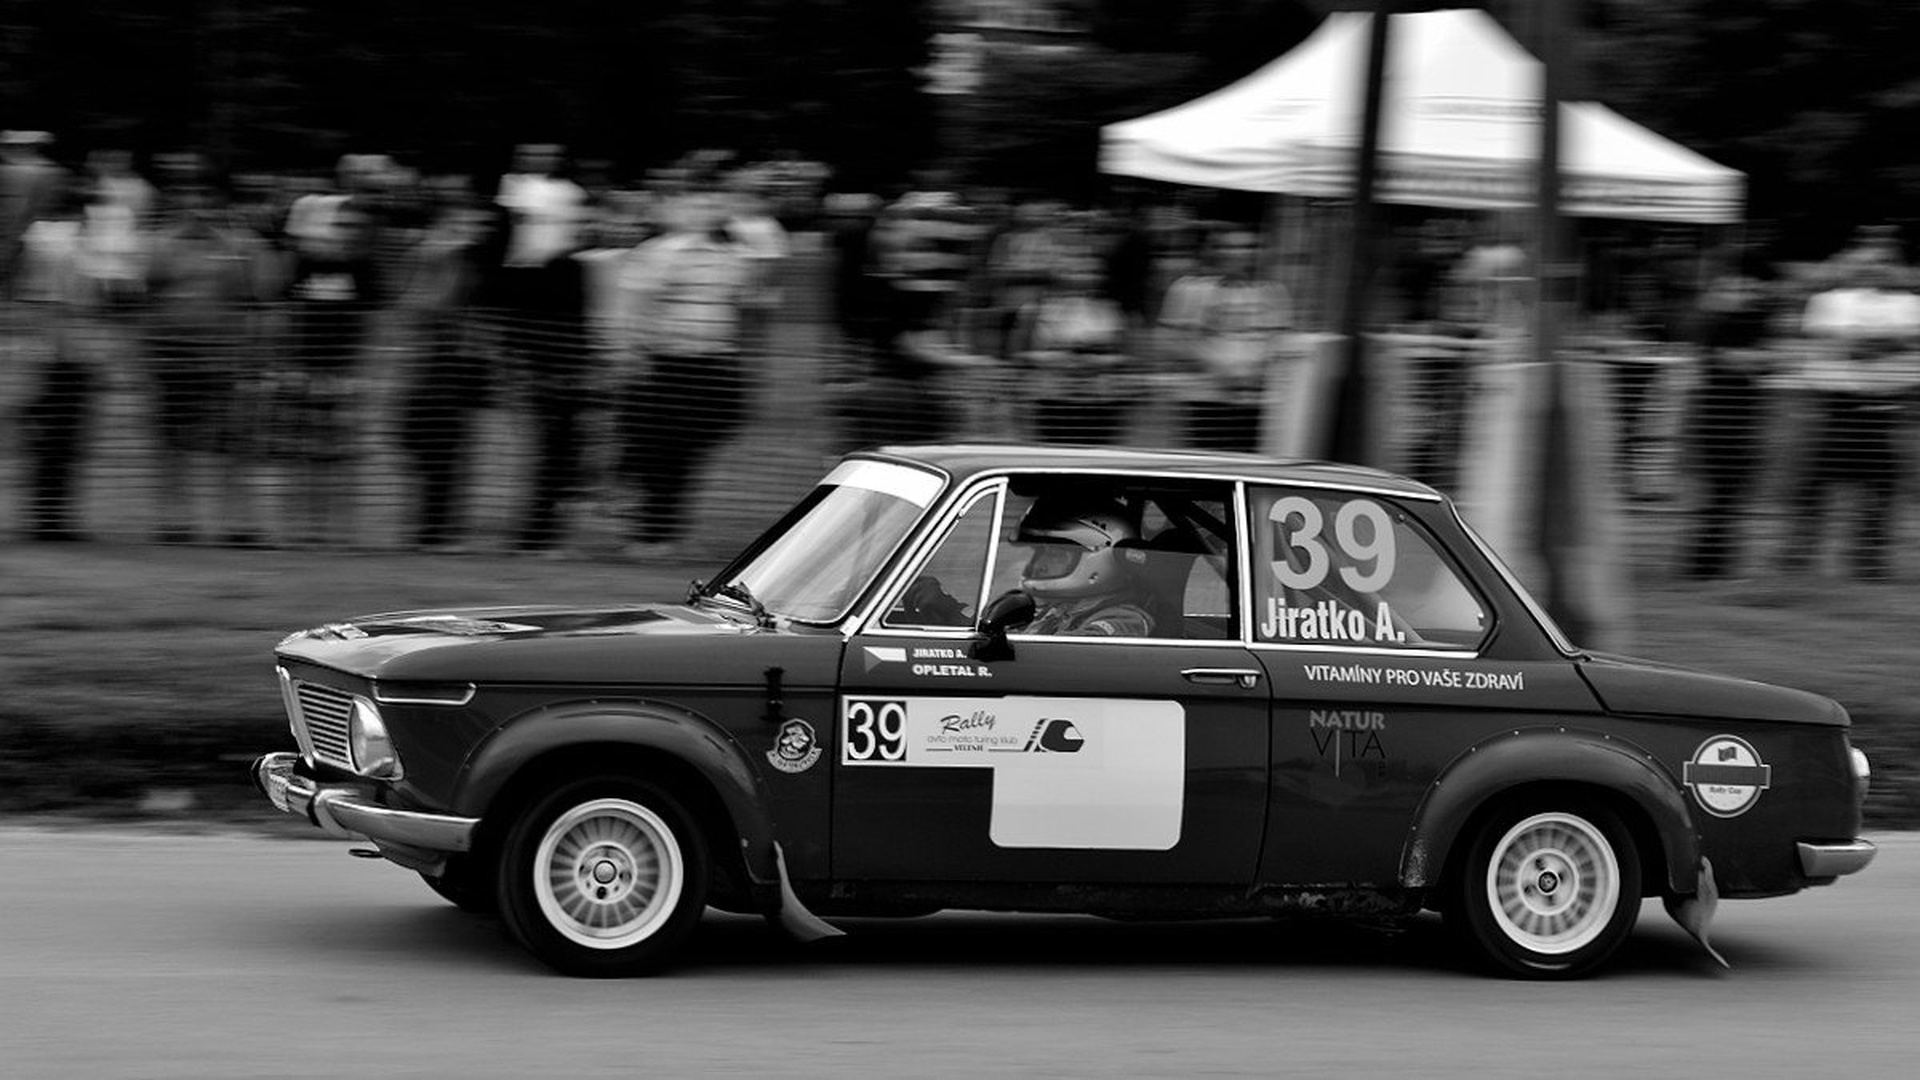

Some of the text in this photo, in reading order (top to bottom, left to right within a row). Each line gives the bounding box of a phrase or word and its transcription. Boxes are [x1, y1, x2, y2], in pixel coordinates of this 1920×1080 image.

[1268, 496, 1396, 593] 39
[1261, 597, 1406, 642] Jiratko A.
[912, 648, 967, 659] JIRATKO A.
[912, 664, 993, 677] OPLETAL R.
[1304, 664, 1524, 690] VITAMÍNY PRO VAŠE ZDRAVÍ
[848, 702, 907, 760] 39
[940, 710, 996, 734] Rally
[1309, 709, 1386, 730] NATUR
[1310, 729, 1386, 778] VITA
